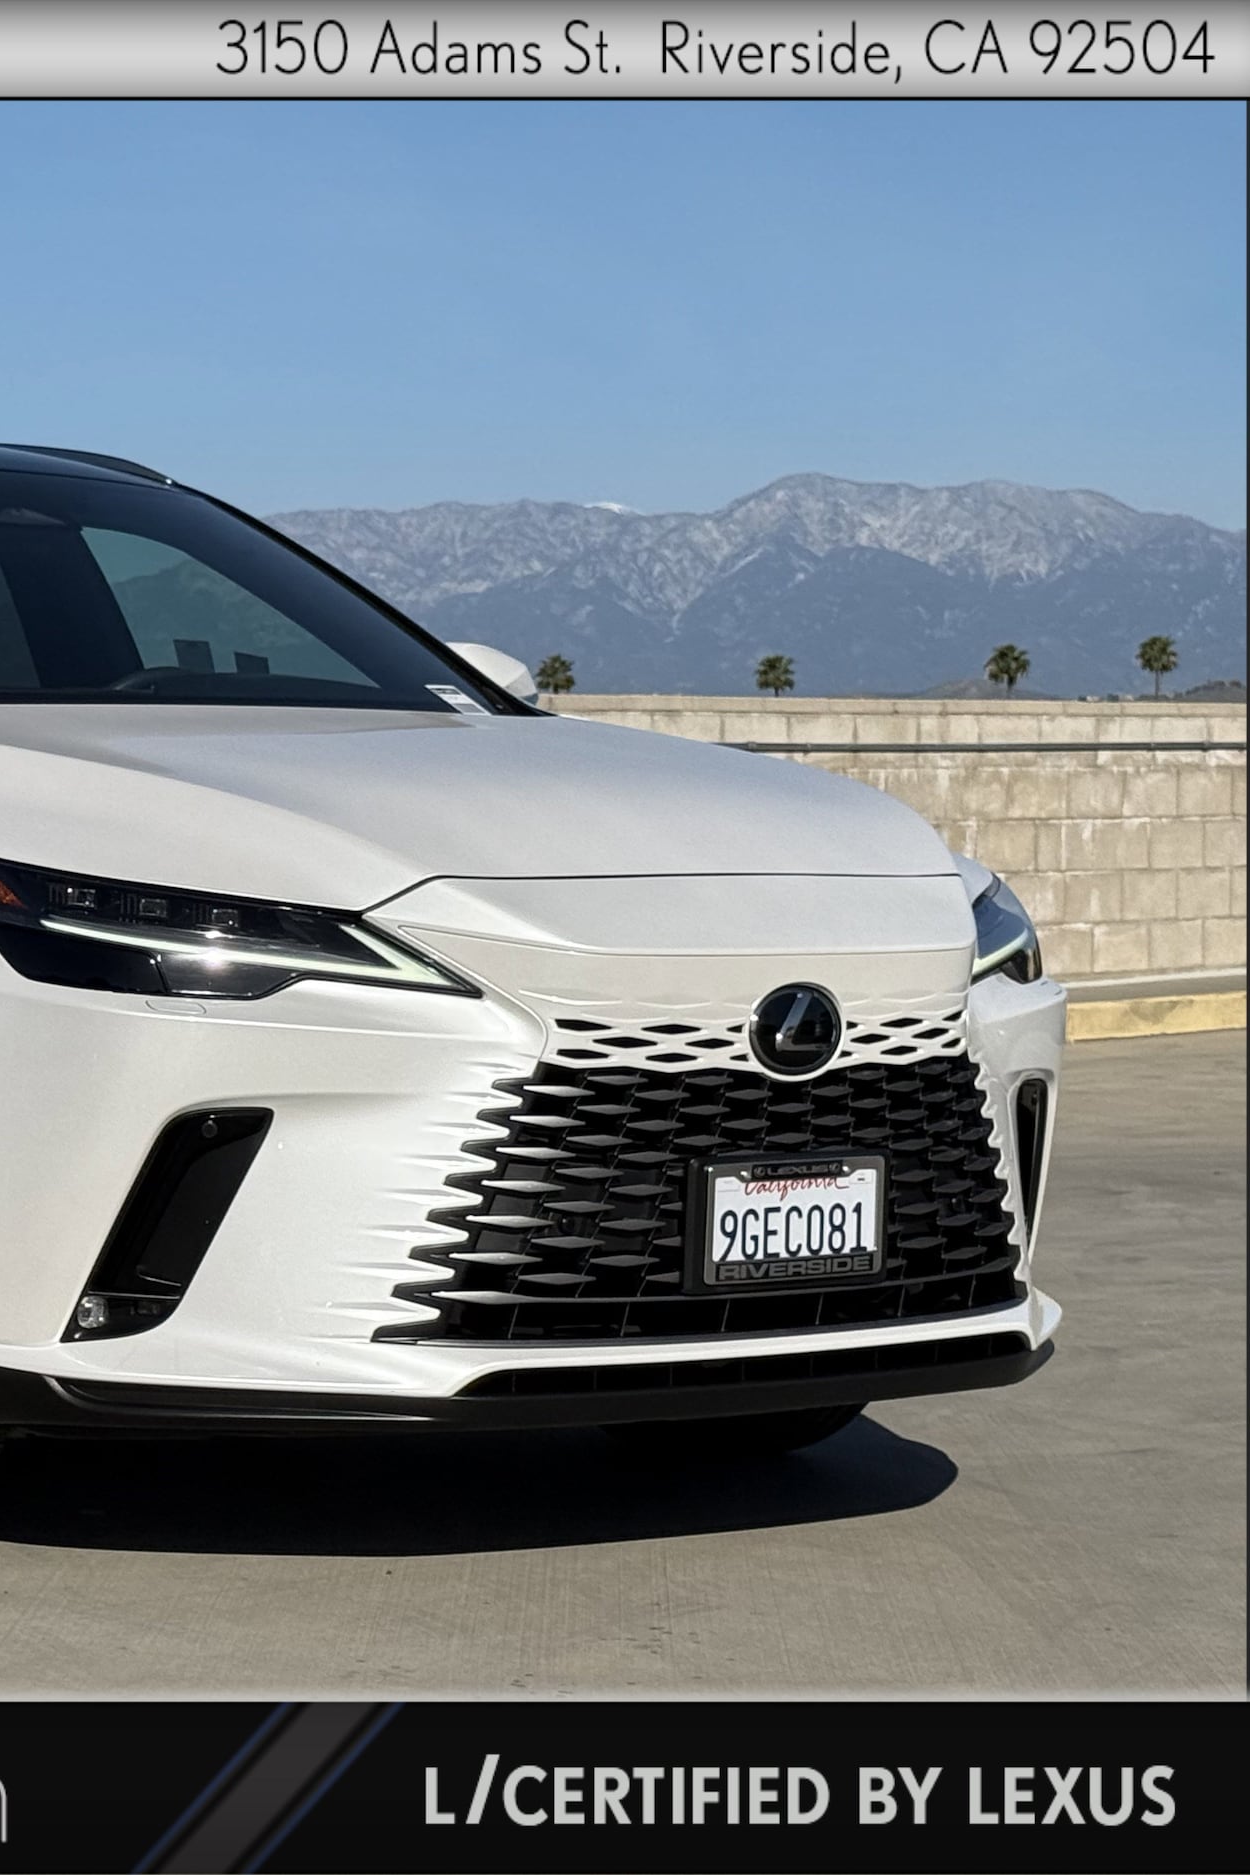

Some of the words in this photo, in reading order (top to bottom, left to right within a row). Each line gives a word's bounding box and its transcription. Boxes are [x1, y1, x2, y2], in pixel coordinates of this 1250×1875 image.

[766, 1163, 829, 1176] LEXUS
[744, 1175, 849, 1202] California
[719, 1201, 868, 1262] 9GEC081
[718, 1255, 871, 1281] RIVERSIDE
